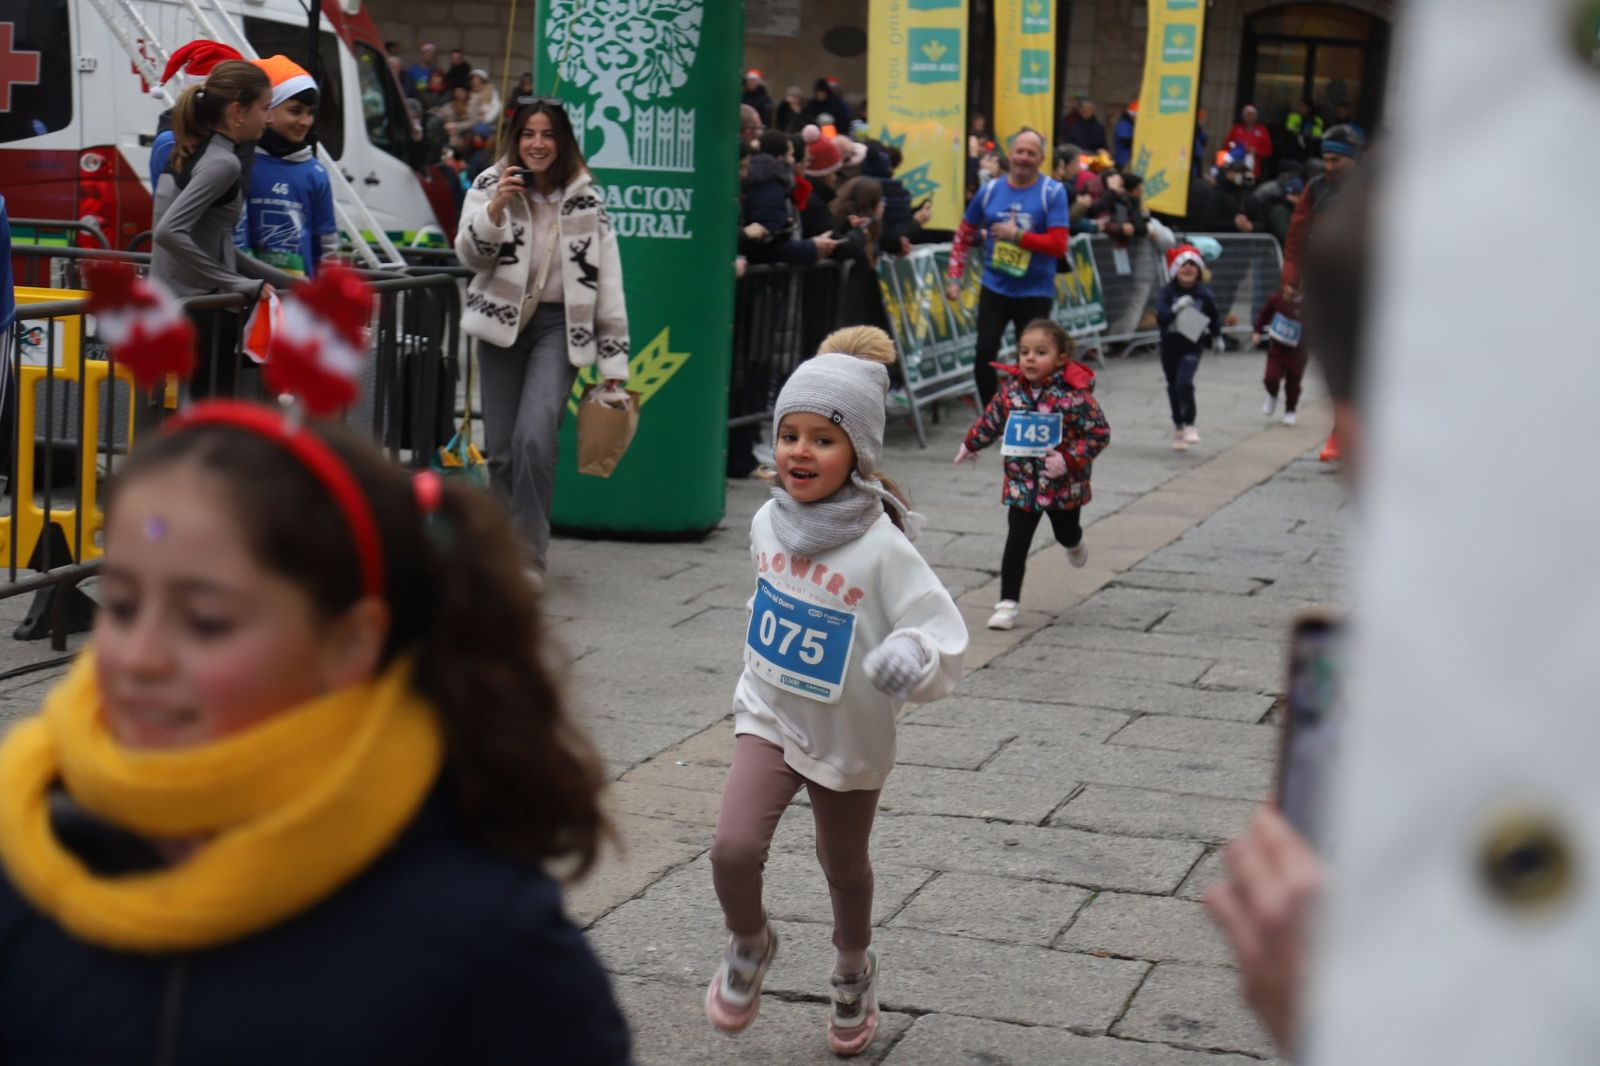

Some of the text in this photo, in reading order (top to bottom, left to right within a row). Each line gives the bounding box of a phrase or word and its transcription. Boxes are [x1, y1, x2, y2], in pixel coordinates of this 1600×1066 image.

[271, 182, 290, 196] 46
[1014, 423, 1050, 442] 143
[756, 552, 864, 606] LOWERS
[759, 609, 829, 665] 075
